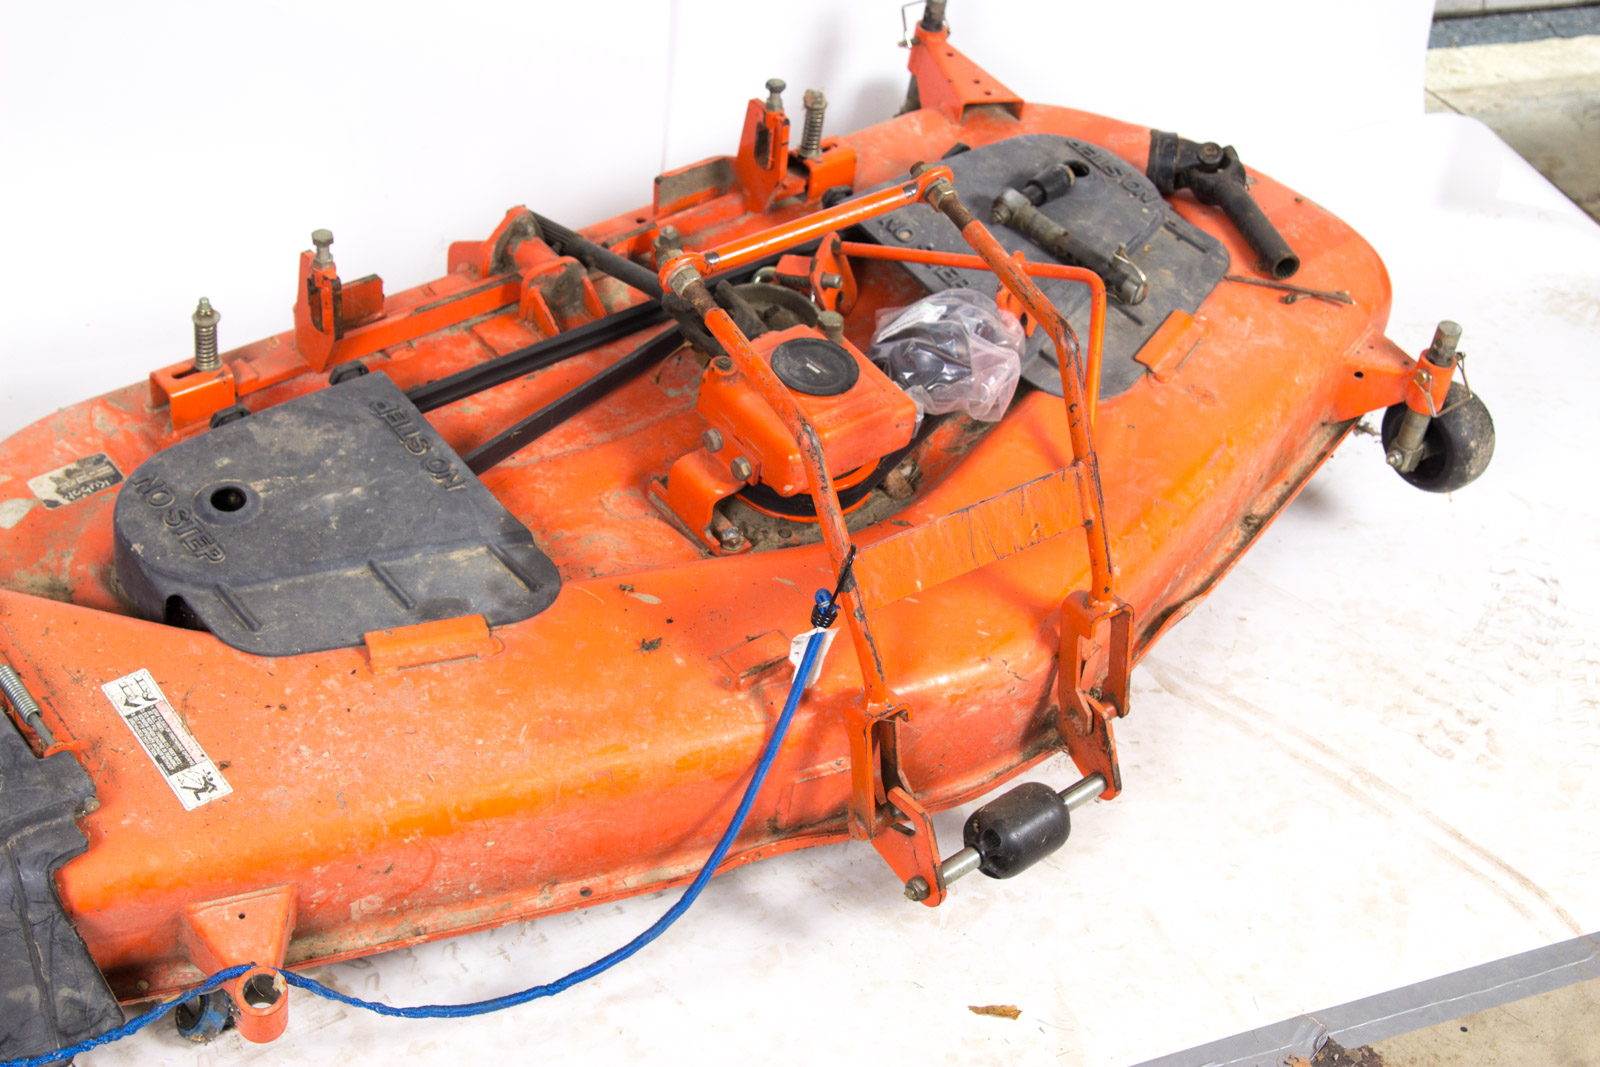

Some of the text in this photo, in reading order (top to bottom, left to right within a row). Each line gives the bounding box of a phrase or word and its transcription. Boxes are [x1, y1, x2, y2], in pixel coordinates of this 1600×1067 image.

[1065, 140, 1158, 204] NO STEP
[878, 217, 916, 244] NO
[369, 399, 468, 491] NO STEP
[132, 472, 226, 563] NO STEP
